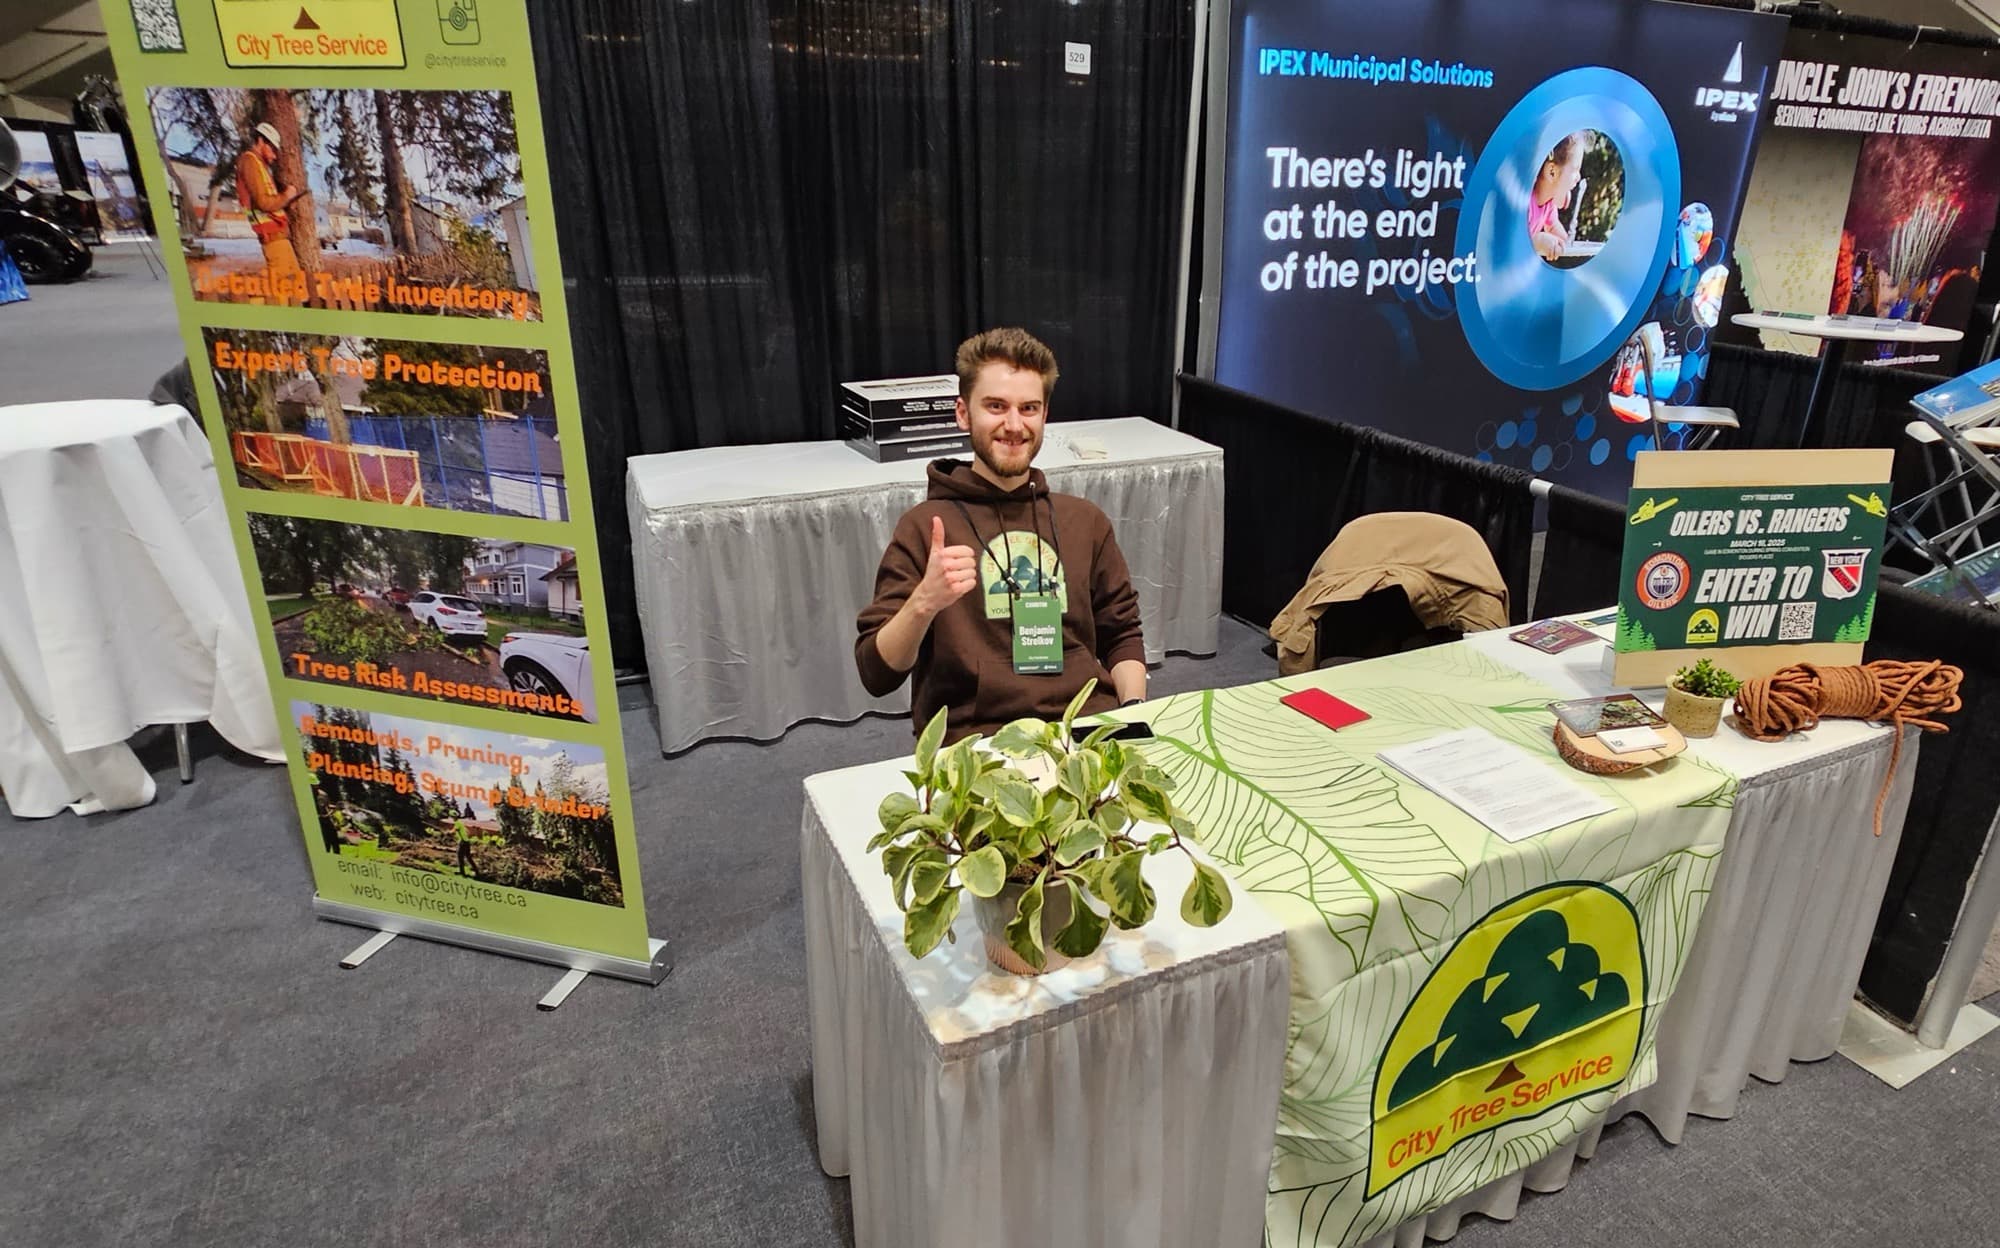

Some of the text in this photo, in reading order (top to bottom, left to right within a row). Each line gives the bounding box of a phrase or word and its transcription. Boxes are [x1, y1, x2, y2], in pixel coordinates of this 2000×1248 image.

[236, 33, 389, 60] City Tree Service
[424, 53, 506, 69] @citytreeservice
[1069, 51, 1085, 63] 529
[1259, 48, 1494, 88] IPEX Municipal Solutions
[1837, 65, 1911, 110] JOHN'S
[1695, 86, 1759, 112] IPEX
[1774, 104, 1819, 128] SERVING
[1816, 107, 1879, 132] COMMUNITIES
[1875, 112, 1899, 134] LIKE
[1896, 114, 1930, 136] YOURS
[1926, 116, 1966, 137] ACROSS
[1265, 146, 1466, 199] There's light
[1263, 200, 1439, 241] at the end
[1260, 248, 1482, 296] of the project.
[198, 266, 529, 322] Detailed Tree Inventory
[214, 340, 543, 393] Expert Tree Protection
[1669, 506, 1851, 537] OILERS VS. RANGERS
[1643, 552, 1687, 570] EDMONTON
[1730, 540, 1757, 548] MARCH
[1694, 565, 1814, 604] ENTER TO
[1018, 624, 1056, 637] Benjamin
[1724, 604, 1778, 640] WIN
[291, 652, 586, 717] Tree Risk Assessments
[299, 714, 531, 777] Removals, Pruning,
[307, 752, 607, 820] Planting, Stump Grinder
[337, 858, 528, 908] email: info@citytree.ca
[350, 882, 480, 920] web: citytree.ca
[1387, 1054, 1614, 1169] City Tree Service
